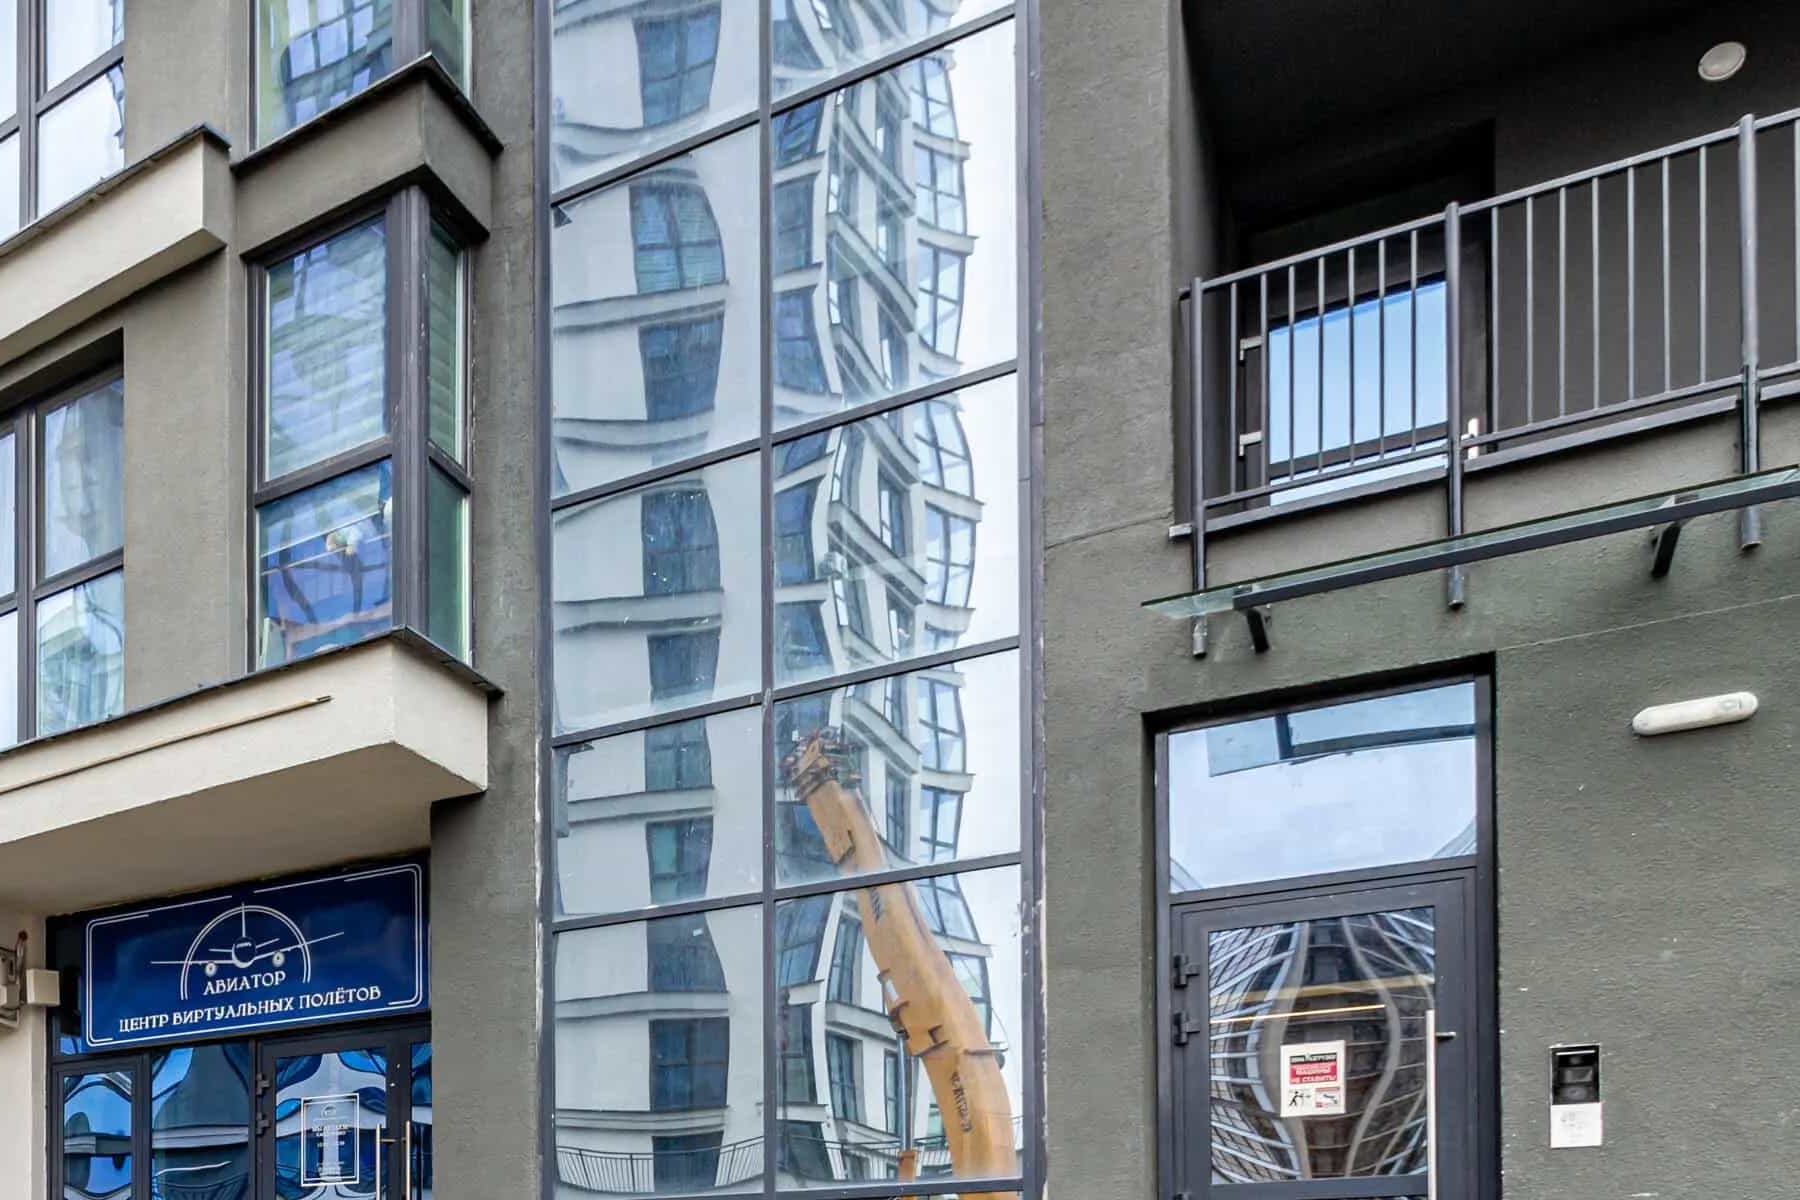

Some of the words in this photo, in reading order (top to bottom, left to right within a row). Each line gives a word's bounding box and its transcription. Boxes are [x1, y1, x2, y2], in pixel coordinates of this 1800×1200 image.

[203, 969, 287, 996] АВИАТОР
[119, 1013, 169, 1033] ЦЕНТР
[172, 996, 295, 1026] ВИРТУАЛЬНЫХ
[299, 984, 382, 1010] ПОЛЁТОВ
